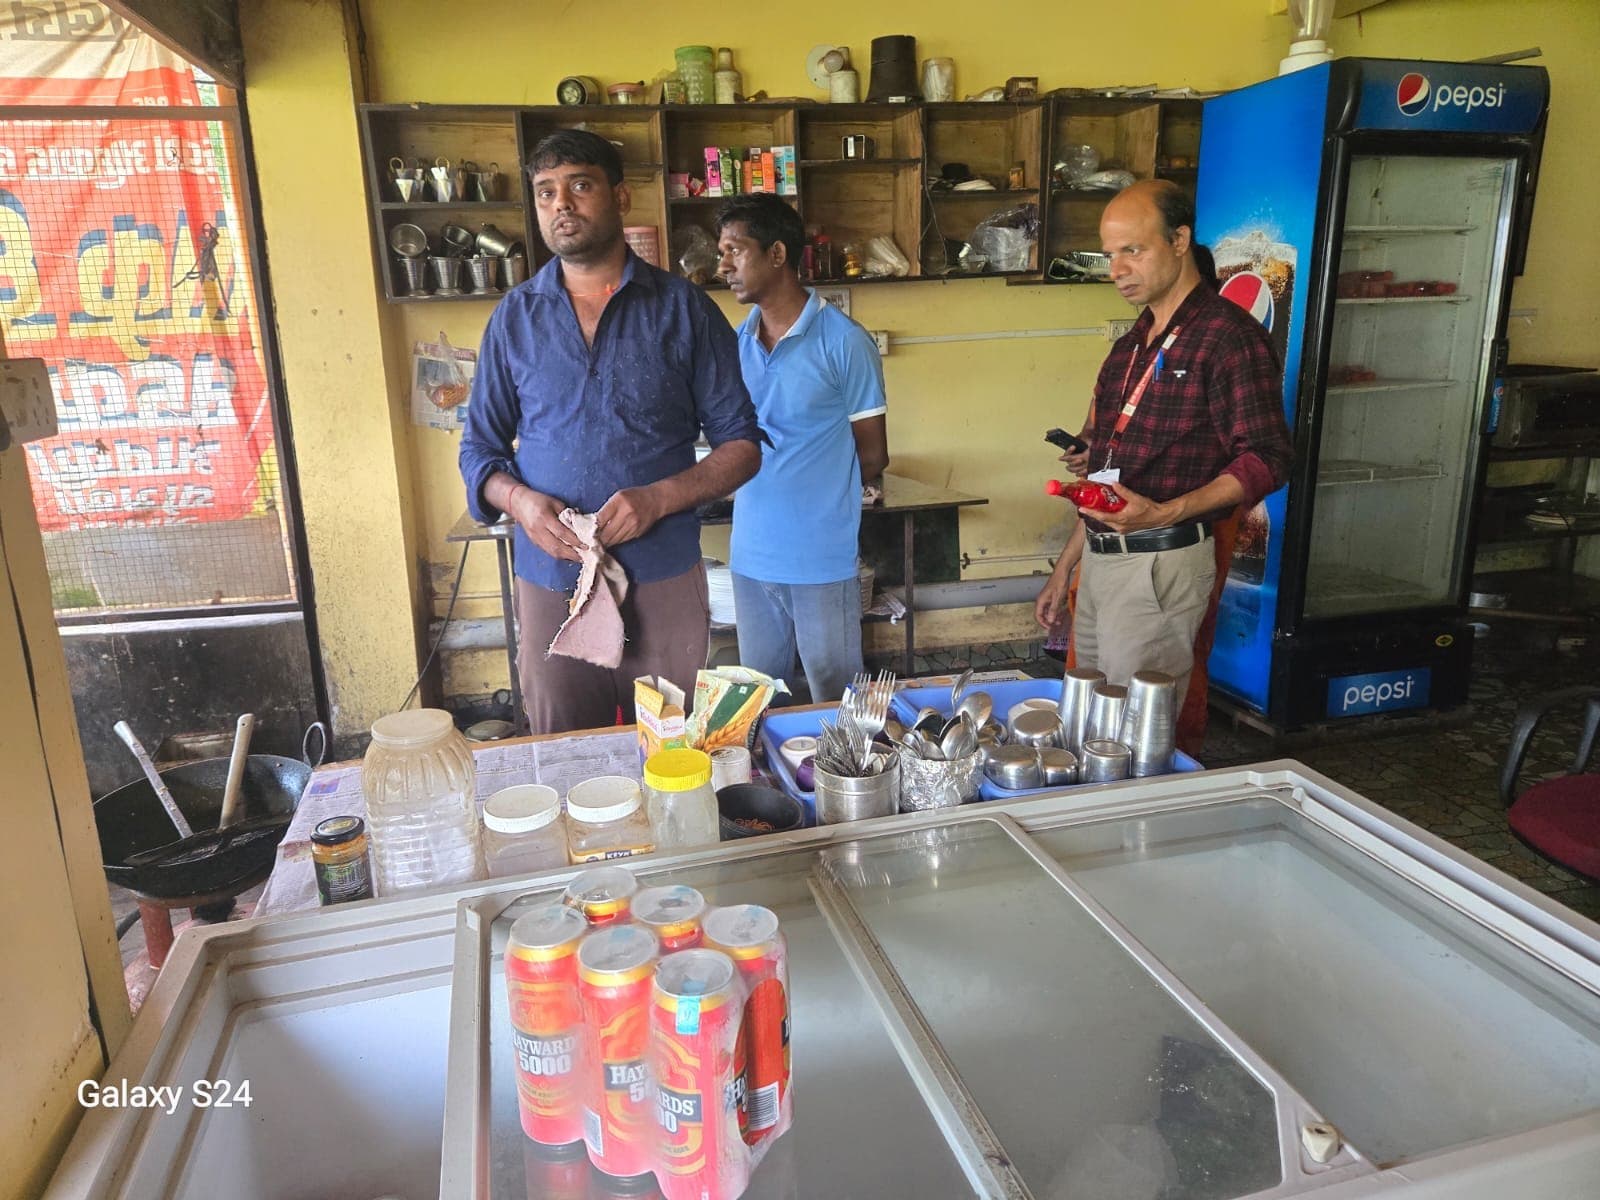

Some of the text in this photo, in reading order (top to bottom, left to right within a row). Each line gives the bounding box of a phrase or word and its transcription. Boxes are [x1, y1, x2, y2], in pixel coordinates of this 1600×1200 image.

[1433, 82, 1505, 113] pepsi
[1343, 675, 1412, 711] pepsi
[519, 1050, 572, 1076] 5000
